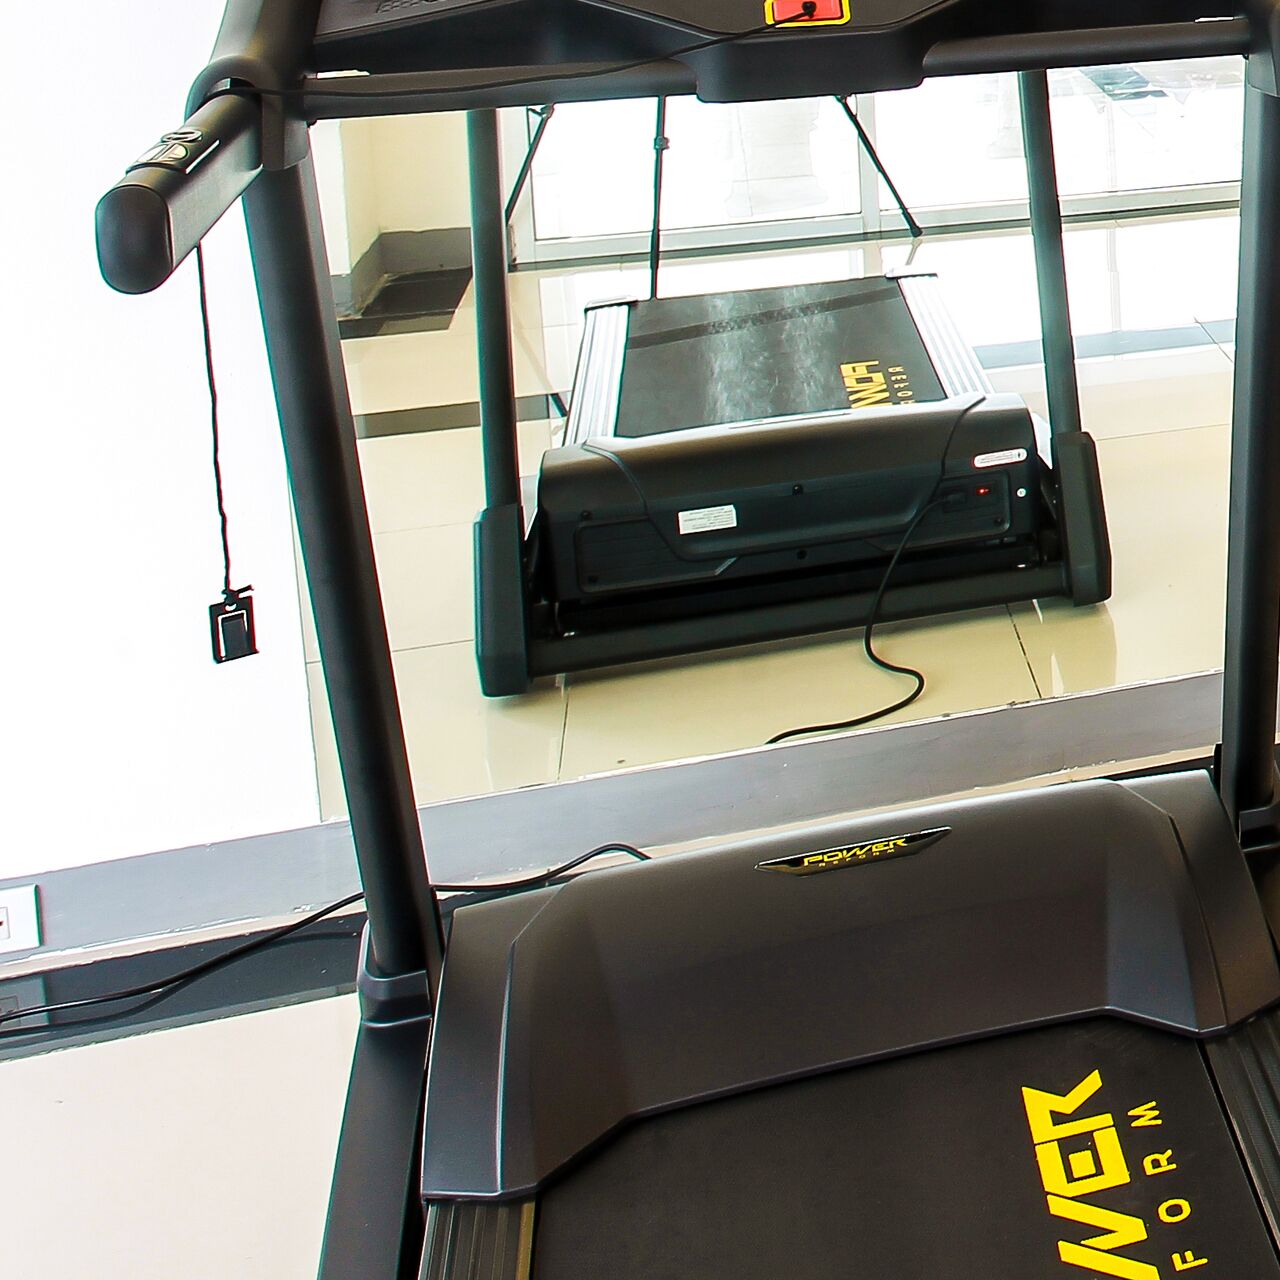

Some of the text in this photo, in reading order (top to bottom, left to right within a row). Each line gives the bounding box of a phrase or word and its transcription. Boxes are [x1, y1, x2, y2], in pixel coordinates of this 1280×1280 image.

[803, 838, 908, 866] POWER
[1021, 1069, 1162, 1280] WER
[1127, 1100, 1209, 1272] FORM
